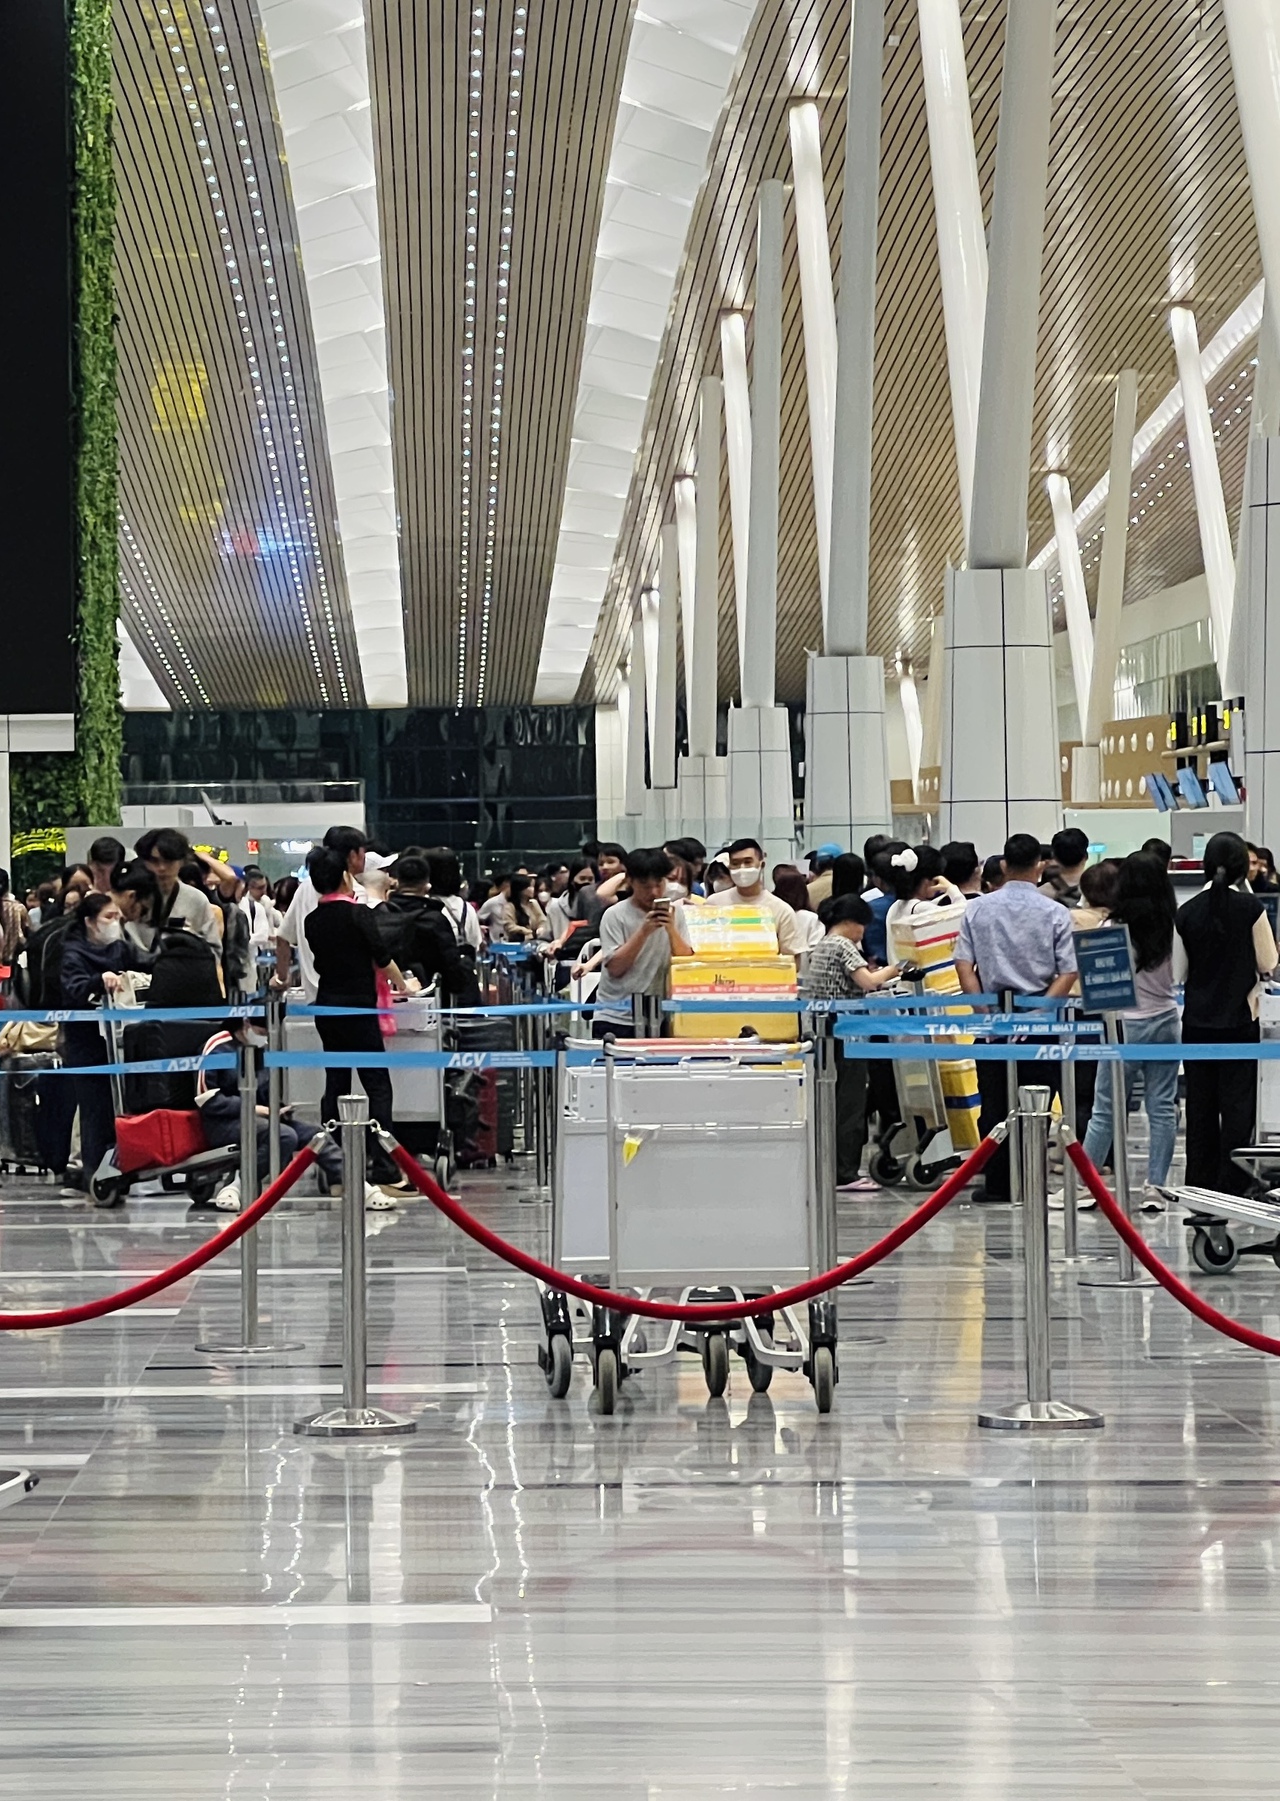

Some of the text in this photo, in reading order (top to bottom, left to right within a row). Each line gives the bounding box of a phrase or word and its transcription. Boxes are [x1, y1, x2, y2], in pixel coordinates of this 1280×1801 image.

[229, 1005, 256, 1017] ACV
[806, 1001, 833, 1011] ACV
[45, 1010, 73, 1021] ACV
[924, 1024, 961, 1035] TIA
[1034, 1044, 1074, 1060] ACV
[447, 1052, 488, 1068] ACV
